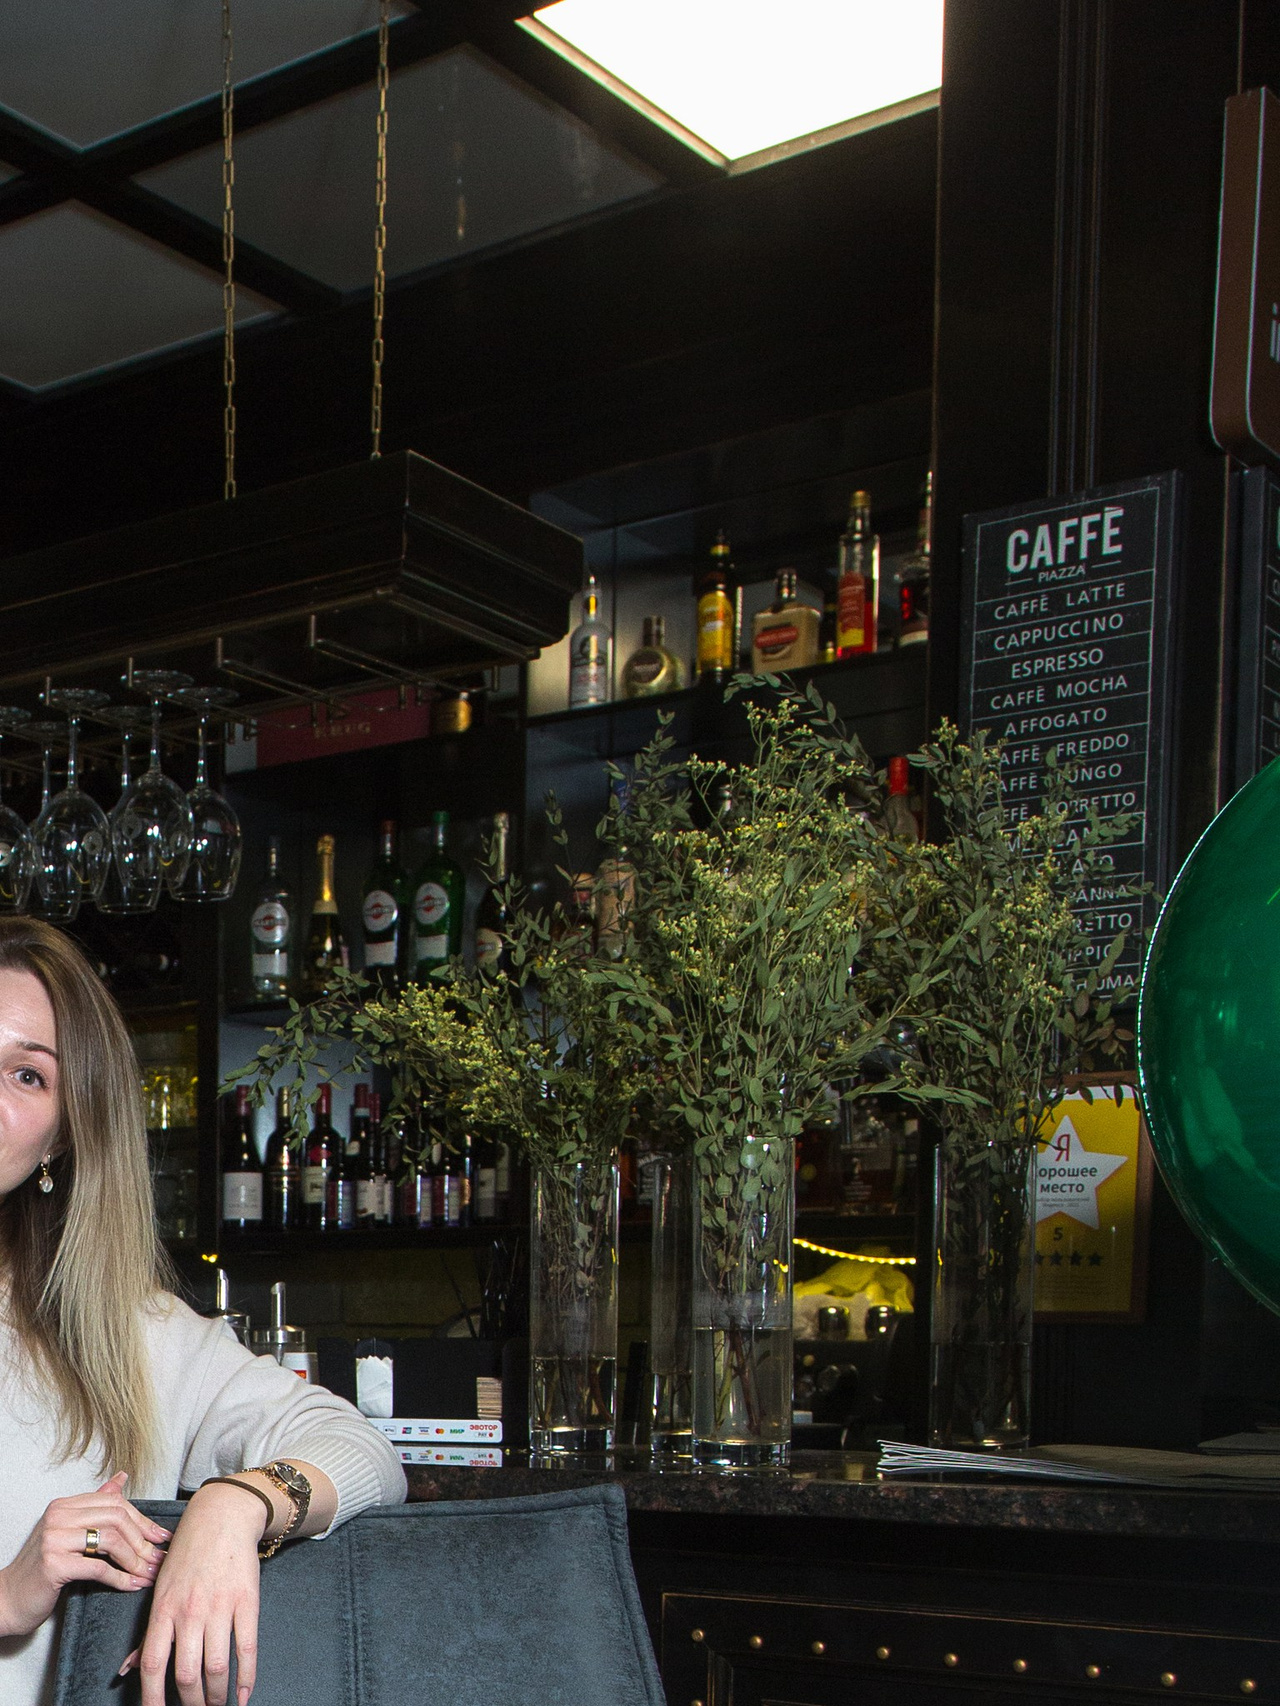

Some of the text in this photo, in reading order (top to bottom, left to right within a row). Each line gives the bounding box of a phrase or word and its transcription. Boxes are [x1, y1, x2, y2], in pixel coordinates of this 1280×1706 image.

[1038, 564, 1087, 583] PIAZZA
[1065, 582, 1126, 607] LATTE
[994, 613, 1124, 651] CAPPUCCINO
[1011, 648, 1104, 679] ESPRESSO
[1057, 674, 1128, 699] MOCHA
[1004, 707, 1107, 737] AFFOGATO
[992, 733, 1130, 768] AFFÈ FREDDO
[1045, 791, 1136, 816] ORRETTO
[1055, 1133, 1071, 1162] Я
[1039, 1166, 1098, 1183] орошее
[1040, 1183, 1085, 1194] место
[1053, 1226, 1064, 1241] 5
